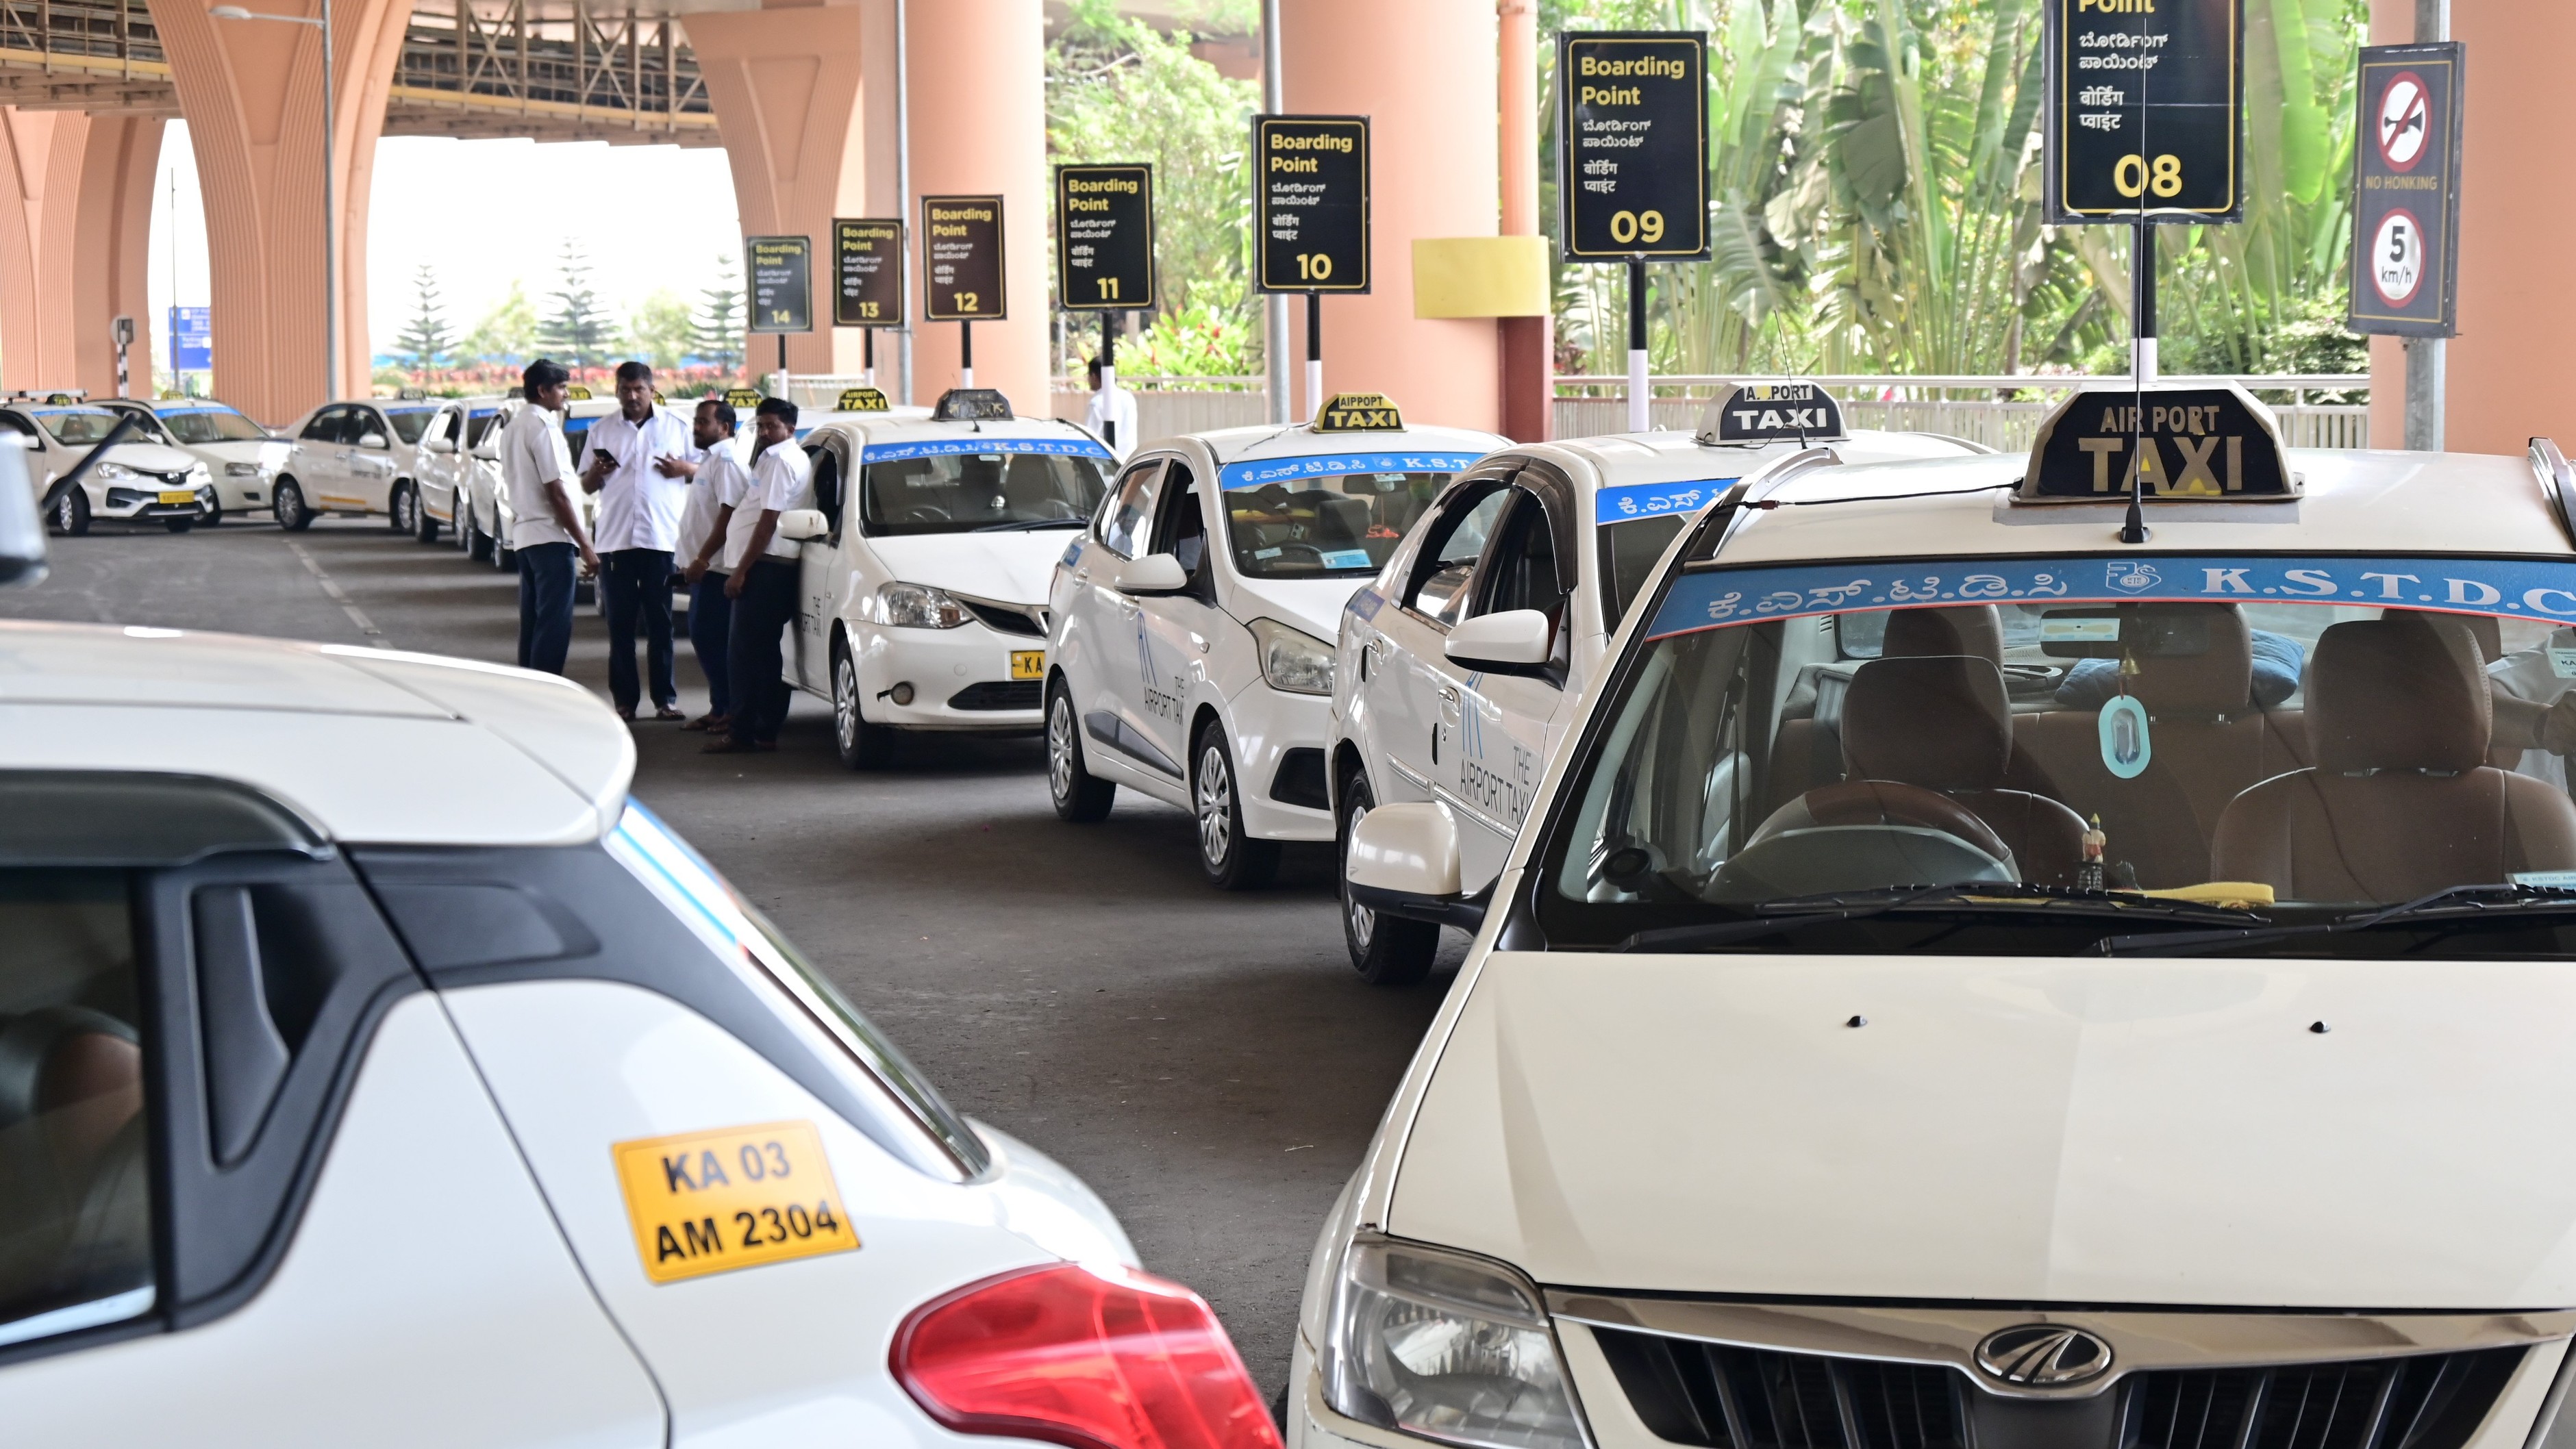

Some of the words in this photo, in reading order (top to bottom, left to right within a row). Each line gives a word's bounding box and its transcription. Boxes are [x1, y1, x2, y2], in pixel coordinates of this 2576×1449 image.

[2079, 31, 2168, 49] ಬೋರ್ಡಿಂಗ್
[1581, 55, 1685, 79] Boarding
[2079, 53, 2158, 69] ಪಾಯಿಂಟ್
[1581, 86, 1641, 105] Point
[2079, 86, 2124, 106] बोर्डिंग
[1582, 118, 1651, 131] ಬೋರ್ಡಿಂಗ್
[2079, 110, 2122, 132] प्वाइंट
[1271, 134, 1353, 153] Boarding
[1582, 135, 1644, 148] ಪಾಯಿಂಟ್
[1271, 156, 1318, 173] Point
[1584, 159, 1618, 175] बोर्डिंग
[2114, 154, 2183, 198] 08
[2366, 176, 2381, 189] NO
[2385, 175, 2438, 190] HONKING
[1068, 178, 1138, 194] Boarding
[1584, 178, 1616, 194] प्वाइंट
[1068, 198, 1109, 212] Point
[932, 207, 992, 222] Boarding
[842, 227, 894, 239] Boarding
[932, 224, 967, 236] Point
[1610, 210, 1664, 243] 09
[755, 244, 801, 255] Boarding
[842, 240, 873, 251] Point
[2389, 225, 2405, 263] 5
[755, 256, 784, 266] Point
[1297, 253, 1332, 280] 10
[2381, 265, 2412, 286] km/h
[1097, 277, 1118, 300] 11
[859, 301, 879, 318] 13
[954, 292, 978, 312] 12
[771, 310, 790, 324] 14
[1746, 385, 1809, 401] APORT
[726, 397, 762, 407] TAXI
[840, 398, 884, 410] TAXI
[1328, 410, 1397, 427] TAXI
[1733, 408, 1827, 430] TAXI
[2100, 406, 2143, 433] AIR
[2152, 405, 2220, 435] PORT
[2078, 436, 2242, 494] TAXI
[1024, 656, 1043, 673] KA
[1175, 676, 1184, 698] THE
[1145, 687, 1171, 720] AIRPORT
[1514, 746, 1531, 786] THE
[1460, 758, 1503, 814] AIRPORT
[662, 1150, 729, 1193] KA
[740, 1142, 792, 1182] 03
[657, 1217, 723, 1263] AM
[734, 1200, 838, 1246] 2304
